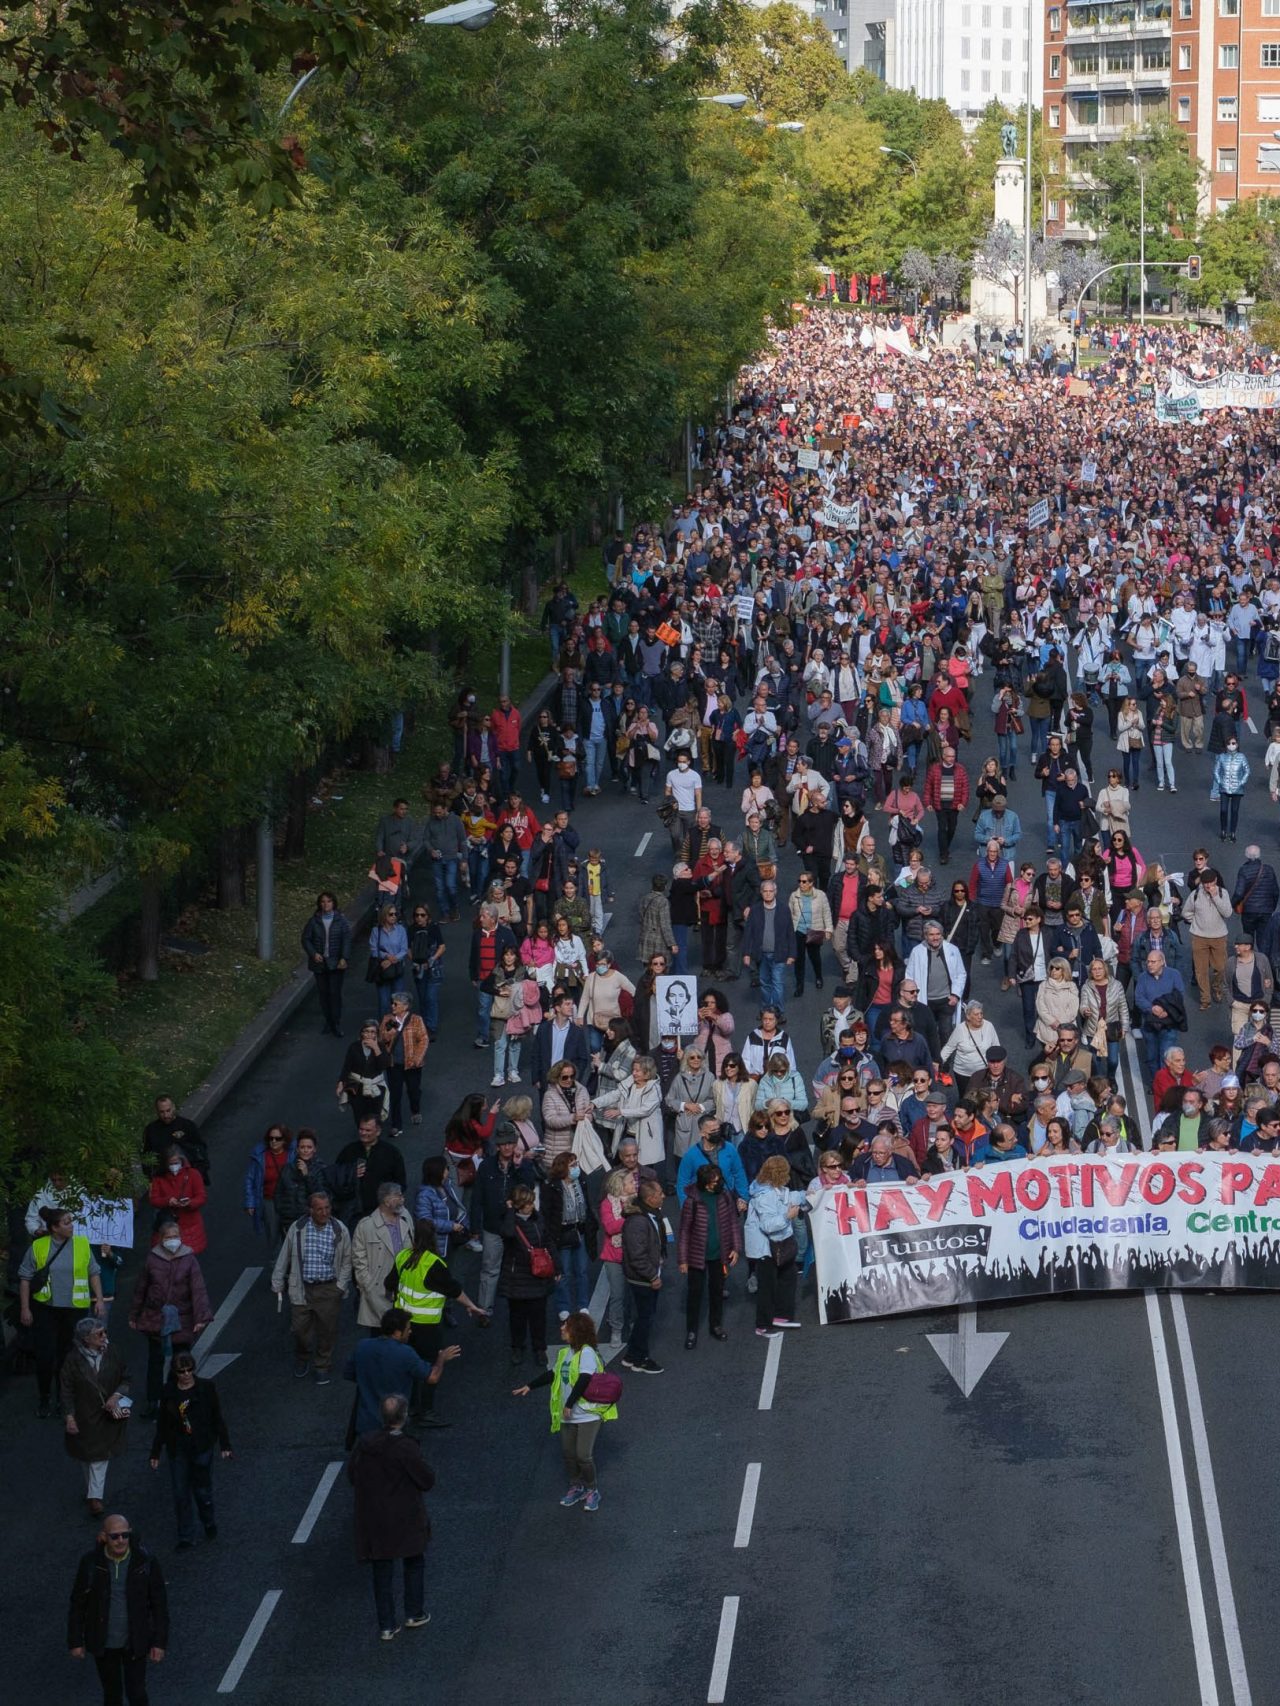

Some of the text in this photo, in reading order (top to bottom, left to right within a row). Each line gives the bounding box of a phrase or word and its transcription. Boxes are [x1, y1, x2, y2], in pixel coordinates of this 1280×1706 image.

[834, 1179, 955, 1236] HAY
[966, 1162, 1207, 1218] MOTIVOS
[1018, 1212, 1169, 1240] Ciudadanía
[864, 1228, 988, 1263] ¡Juntos!
